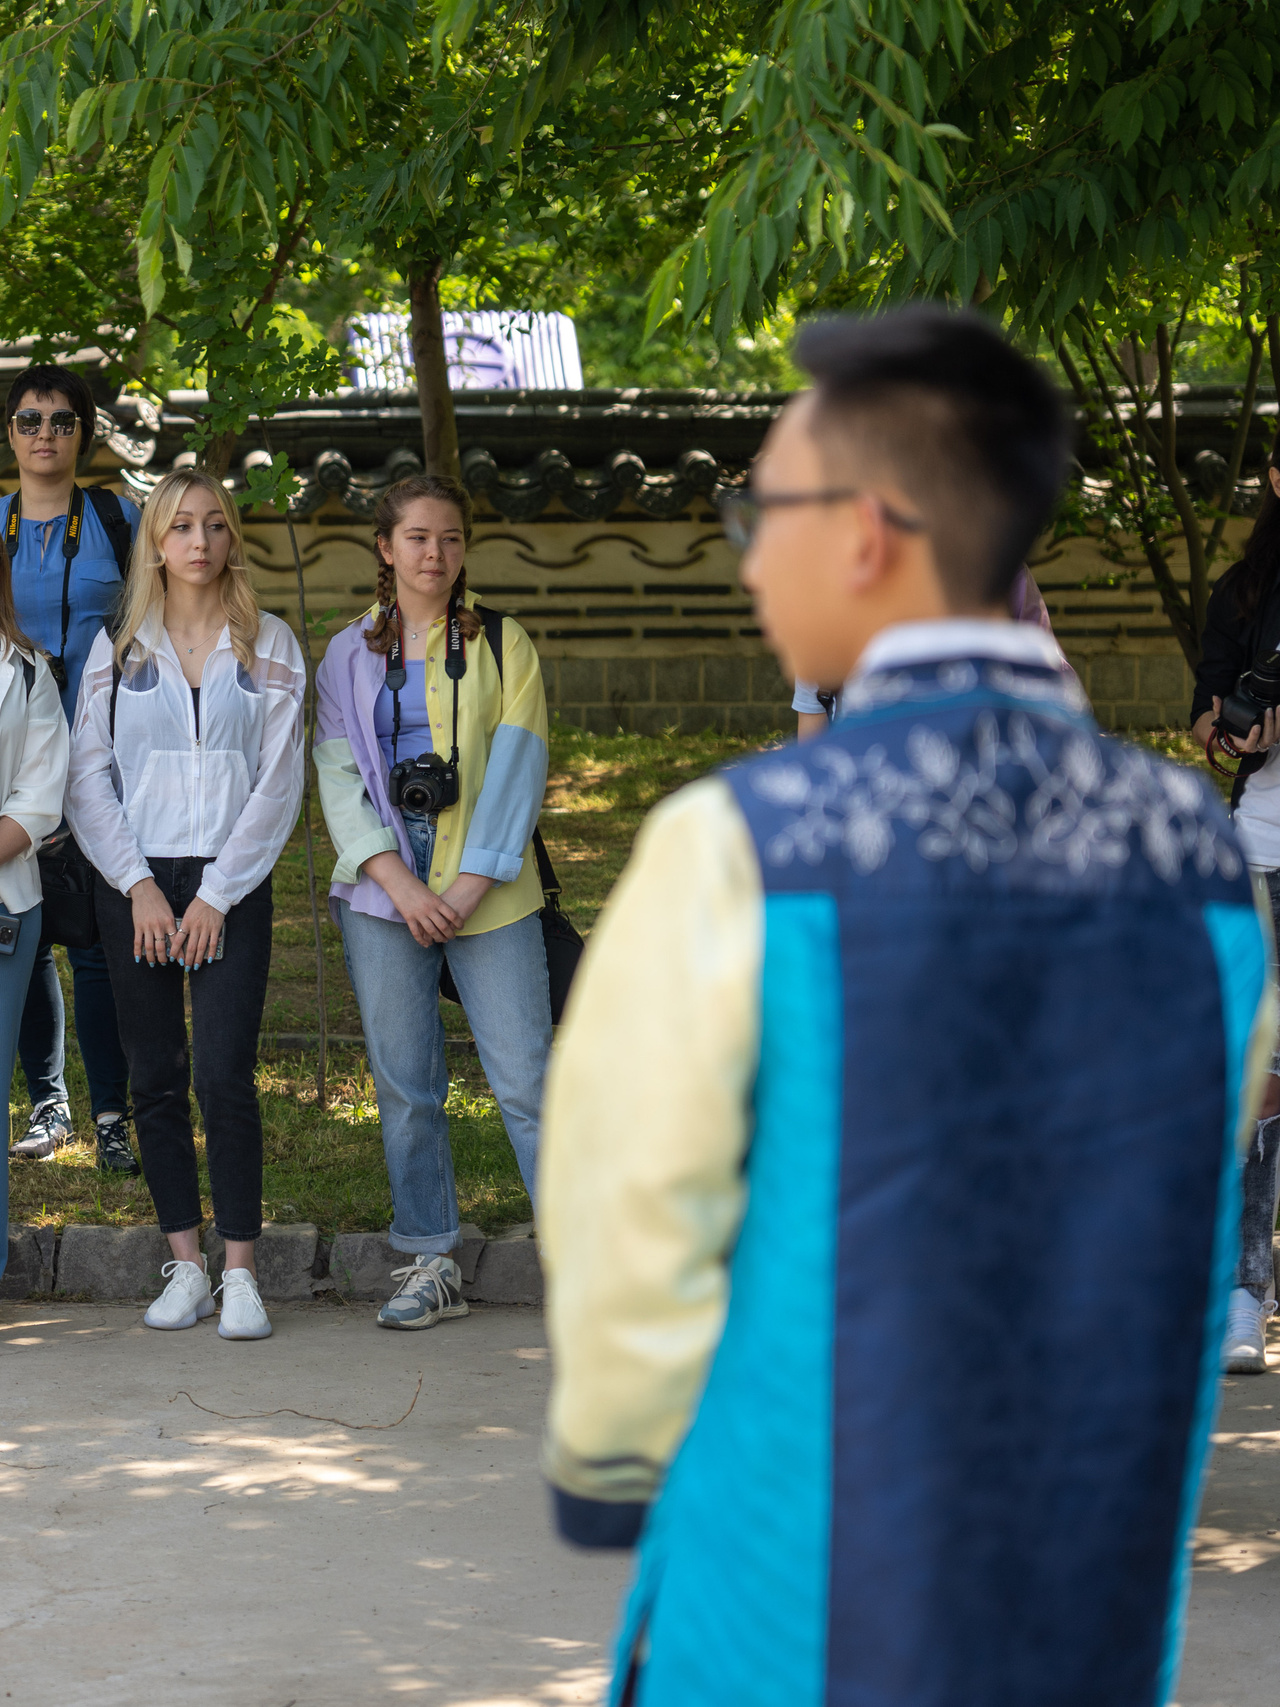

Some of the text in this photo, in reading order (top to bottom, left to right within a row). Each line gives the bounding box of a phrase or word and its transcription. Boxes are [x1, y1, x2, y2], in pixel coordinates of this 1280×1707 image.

[8, 513, 18, 536] Nikon
[68, 515, 79, 538] Nikon
[450, 618, 461, 650] Canon
